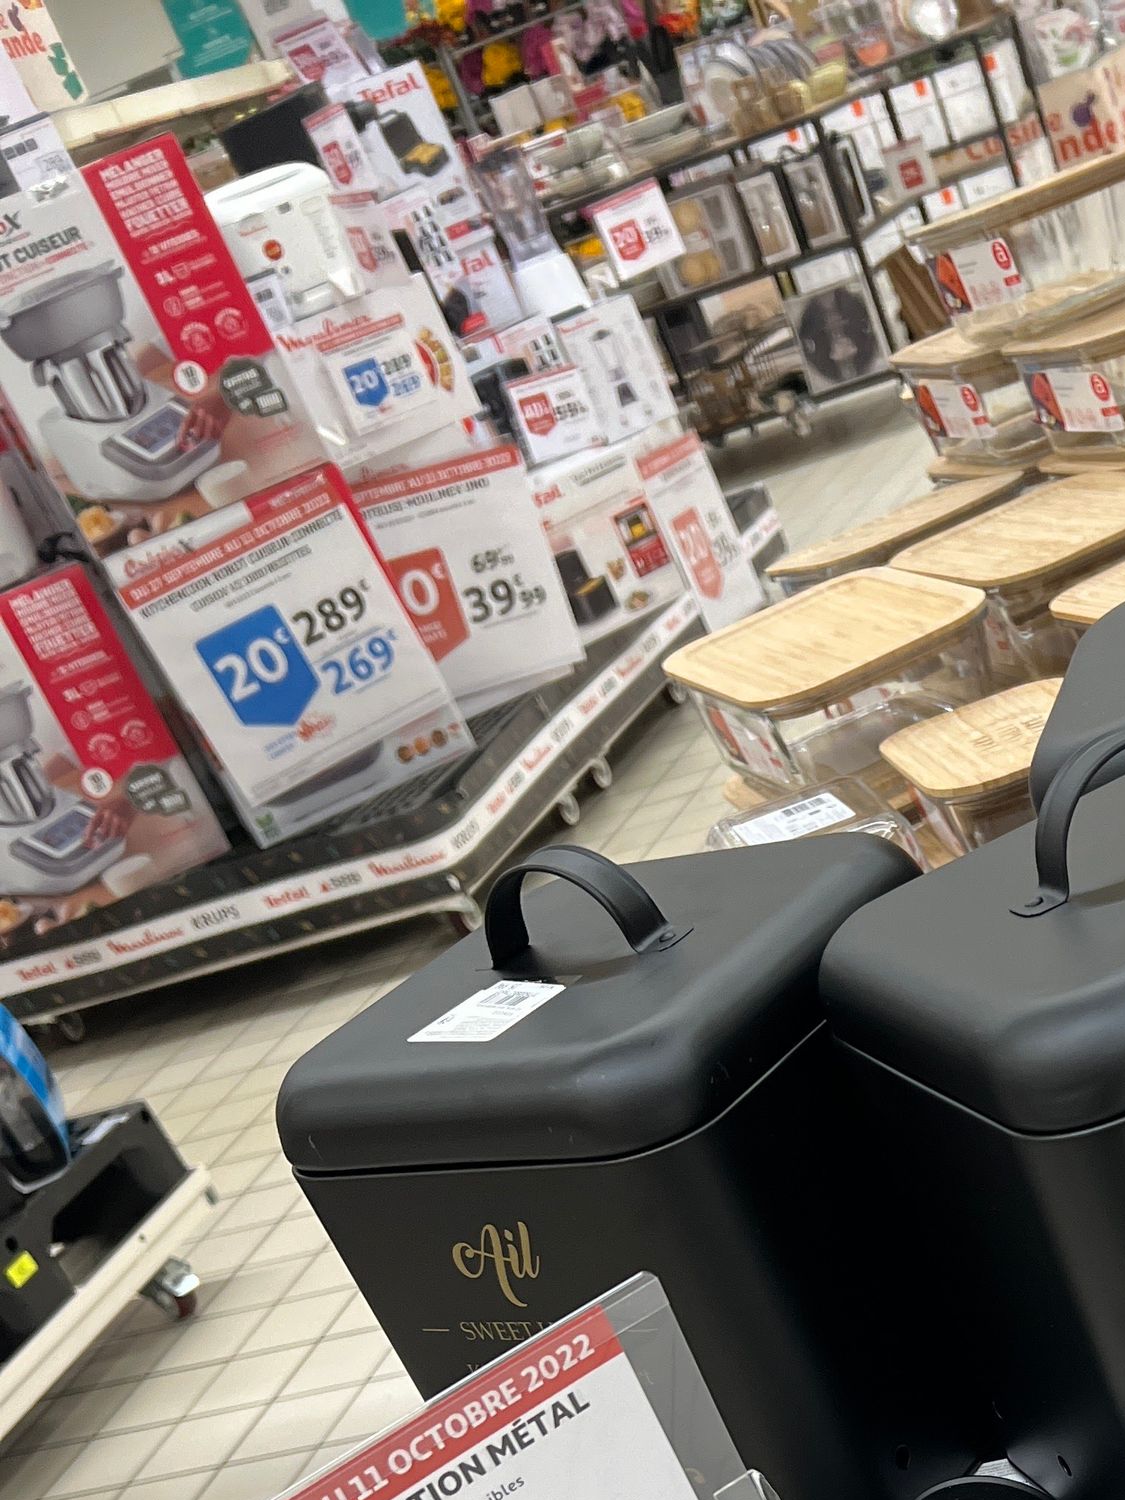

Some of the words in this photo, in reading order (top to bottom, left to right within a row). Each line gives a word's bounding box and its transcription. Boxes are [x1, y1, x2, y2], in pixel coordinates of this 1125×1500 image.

[357, 73, 421, 104] Tefal
[16, 226, 82, 263] CUISEUR
[460, 249, 494, 277] fal
[401, 562, 446, 616] 0€
[462, 573, 547, 623] 39€99
[190, 903, 241, 931] KRUPS
[452, 1221, 541, 1308] Ail
[459, 1321, 533, 1341] SWEET
[387, 1379, 523, 1475] OCTOBRE
[520, 1333, 596, 1393] 2022
[486, 1391, 591, 1467] MÉTAL
